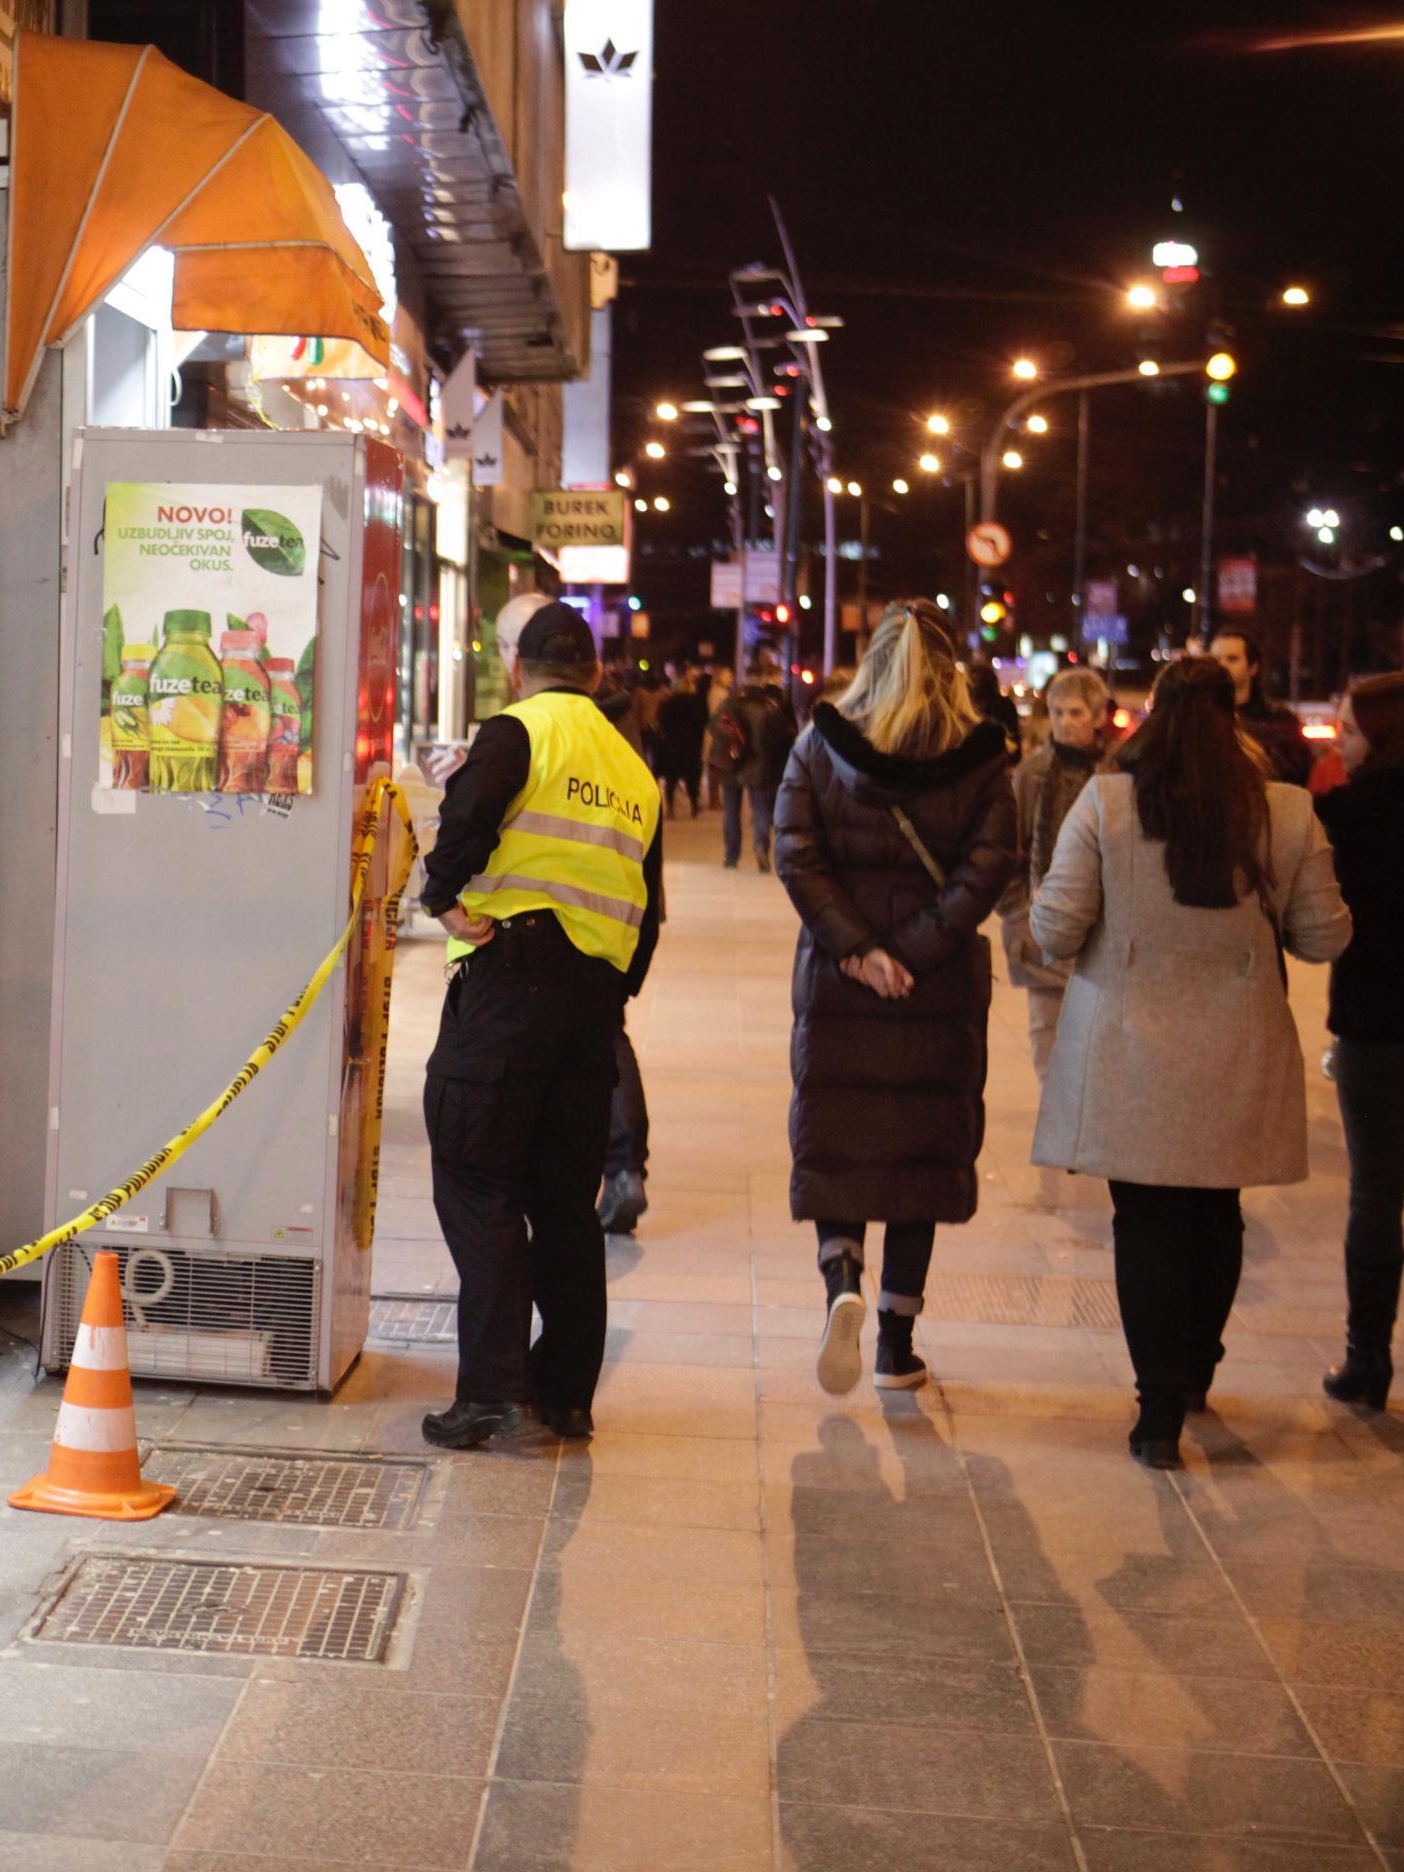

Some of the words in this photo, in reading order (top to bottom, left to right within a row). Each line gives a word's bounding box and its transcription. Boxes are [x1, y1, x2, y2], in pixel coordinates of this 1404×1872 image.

[157, 506, 233, 524] NOVO!
[544, 500, 608, 515] BUREK
[118, 528, 195, 541] UZBUDLJIV
[139, 541, 231, 557] NEOČEKIVAN
[189, 559, 234, 572] OKUS.
[149, 673, 221, 694] fuzetea
